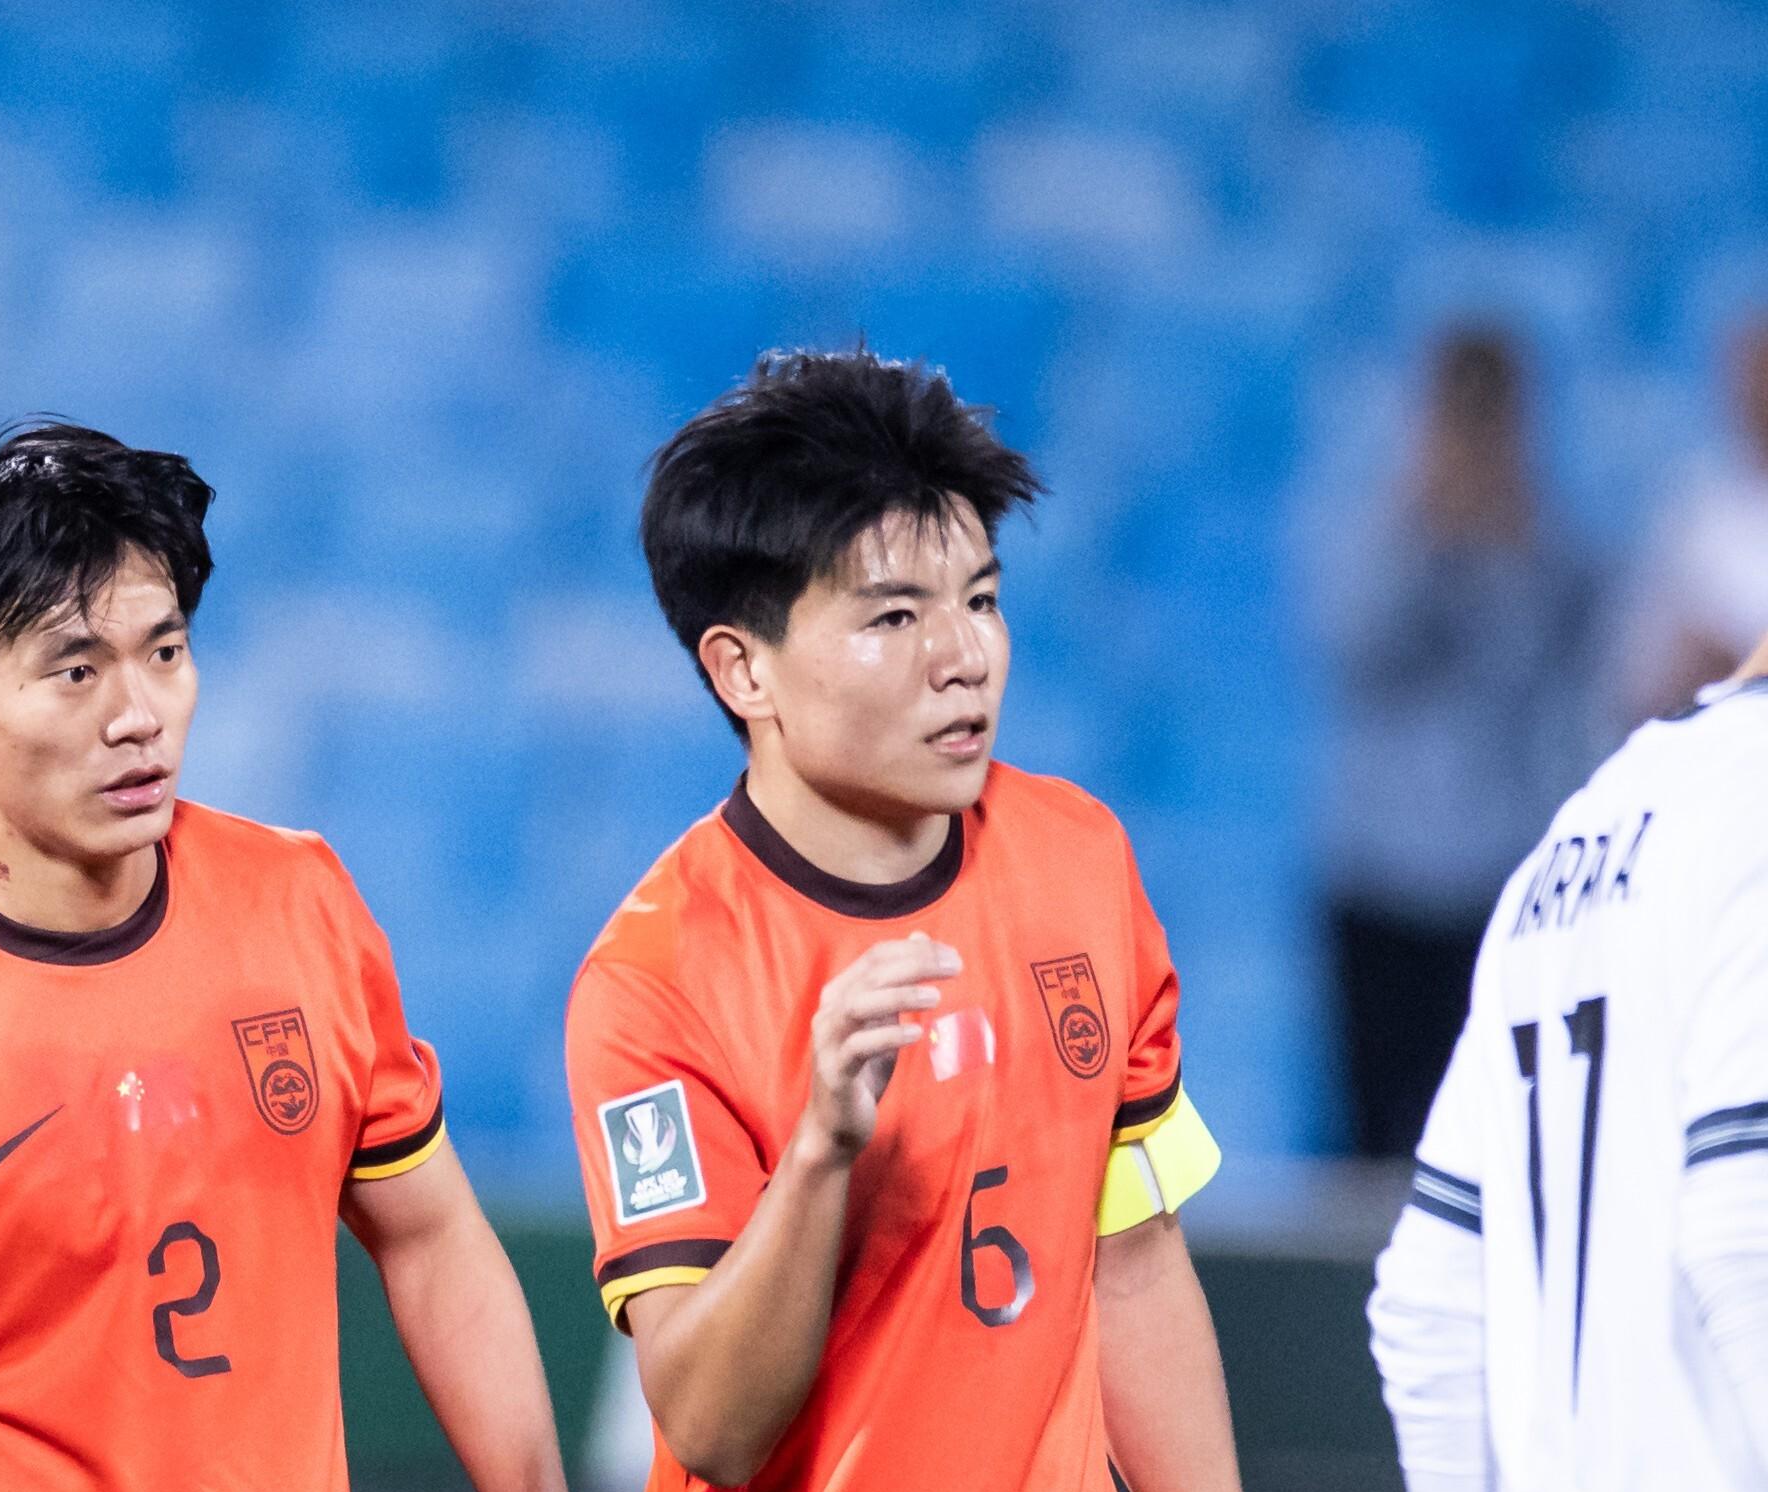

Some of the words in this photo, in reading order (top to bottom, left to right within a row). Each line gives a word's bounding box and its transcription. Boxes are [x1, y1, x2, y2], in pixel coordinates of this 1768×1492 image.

[1040, 962, 1090, 989] CFA
[242, 1017, 301, 1046] CFA
[961, 1165, 1035, 1328] 6
[147, 1220, 232, 1378] 2
